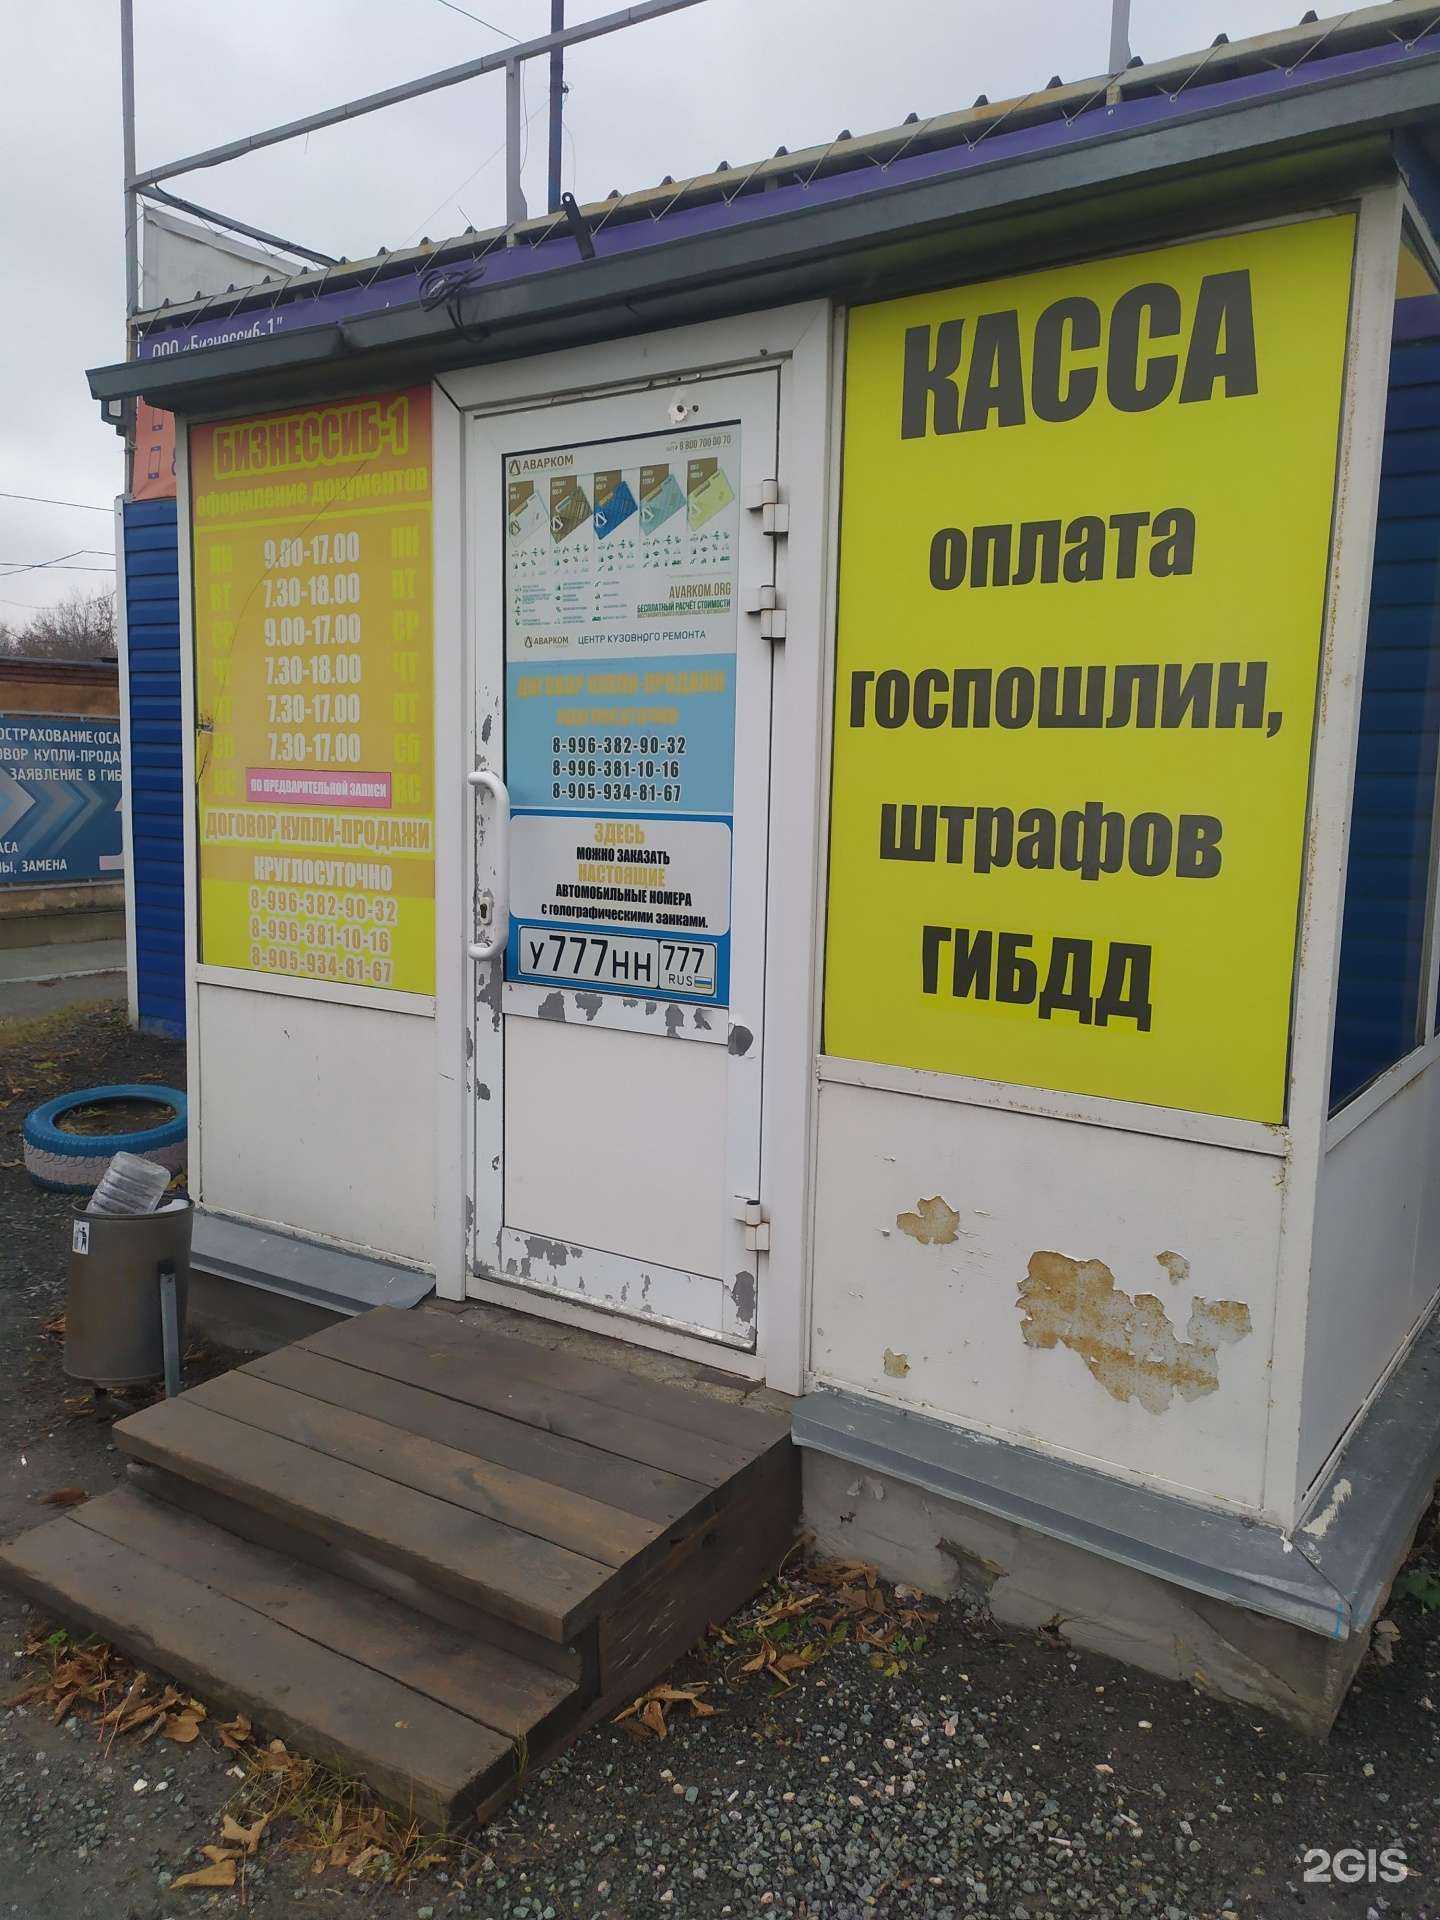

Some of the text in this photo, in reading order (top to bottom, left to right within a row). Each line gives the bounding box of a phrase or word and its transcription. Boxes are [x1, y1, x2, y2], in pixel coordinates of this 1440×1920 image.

[900, 268, 1259, 441] КАССА
[213, 396, 409, 481] БИЗНЕССИБ-1
[523, 454, 574, 471] АВАРКОМ
[311, 467, 428, 507] документов
[929, 507, 1197, 591] оплата
[263, 572, 360, 608] 7.30-18.00
[669, 582, 731, 599] AVARKOM.ORG
[264, 612, 360, 647] 9.00-17.00
[534, 630, 706, 646] АВАРКОМ ЦЕНТР КУЗОВНОГО РЕМОНТА
[264, 654, 361, 684] 7.30-18.00
[267, 693, 360, 723] 7.30-17.00
[34, 749, 122, 764] КУПЛИ-ПРОДА
[266, 732, 361, 763] 7.30-17.00
[552, 737, 686, 754] 8-996-382-90-32
[10, 768, 82, 781] ЗАЯВЛЕНИЕ
[88, 769, 96, 781] В
[552, 760, 679, 777] 8-996-381-10-16
[250, 779, 262, 791] ПО
[263, 779, 348, 795] ПРЕДВАРИТЕЛЬНОЙ
[350, 782, 387, 797] ЗАПИСИ
[552, 782, 681, 801] 8-905-934-81-67
[206, 811, 431, 851] ДОГОВОР КУПЛИ-ПРОДАЖИ
[594, 822, 645, 846] ЗДЕСЬ
[879, 801, 1223, 882] штрафов
[22, 859, 68, 872] ЗАМЕНА
[577, 847, 670, 865] МОЖНО ЗАКАЗАТЬ
[254, 856, 392, 889] КРУГЛОСУТОЧНО
[579, 863, 666, 887] НАСТОЯЩИЕ
[250, 887, 397, 923] 8-996-382-90-32
[556, 884, 692, 906] АВТОМОБИЛЬНЫЕ НОМЕРА
[549, 904, 654, 923] голографическими
[663, 945, 704, 973] 777
[668, 973, 693, 987] RUS
[921, 925, 1153, 1033] ГИБДД
